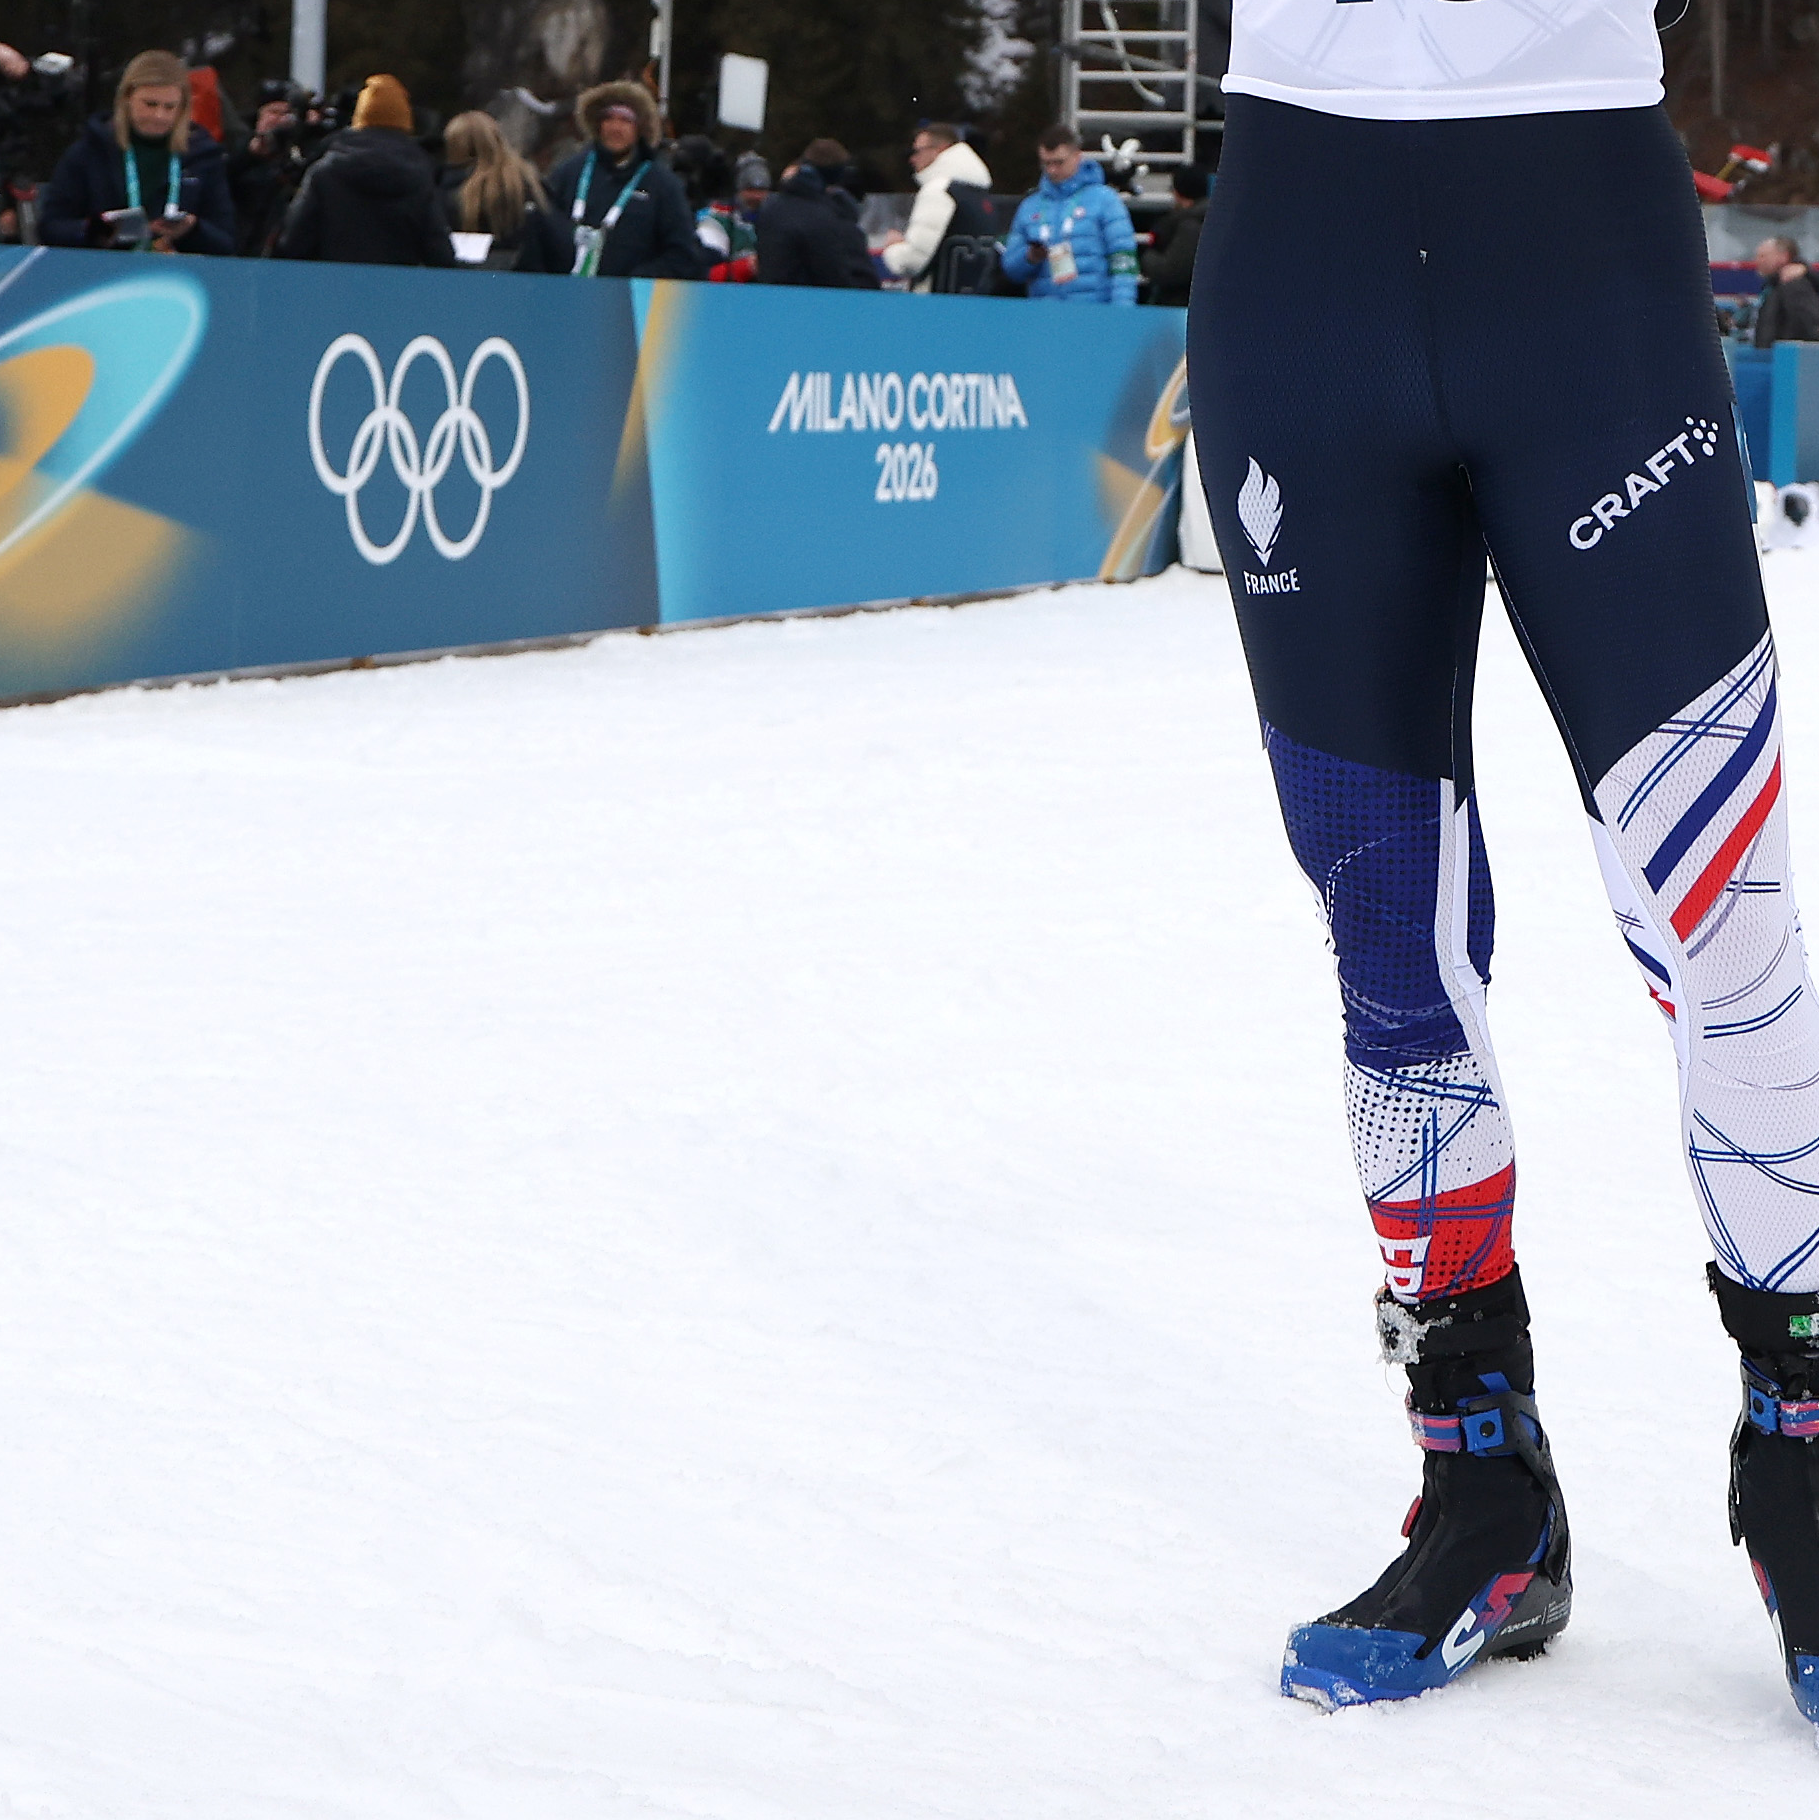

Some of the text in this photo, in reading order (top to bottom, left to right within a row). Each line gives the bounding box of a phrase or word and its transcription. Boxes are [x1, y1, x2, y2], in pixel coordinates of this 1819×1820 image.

[767, 370, 1029, 432] MILANO CORTINA
[874, 440, 939, 502] 2026
[1569, 431, 1696, 551] CRAFT
[1243, 567, 1301, 595] FRANCE
